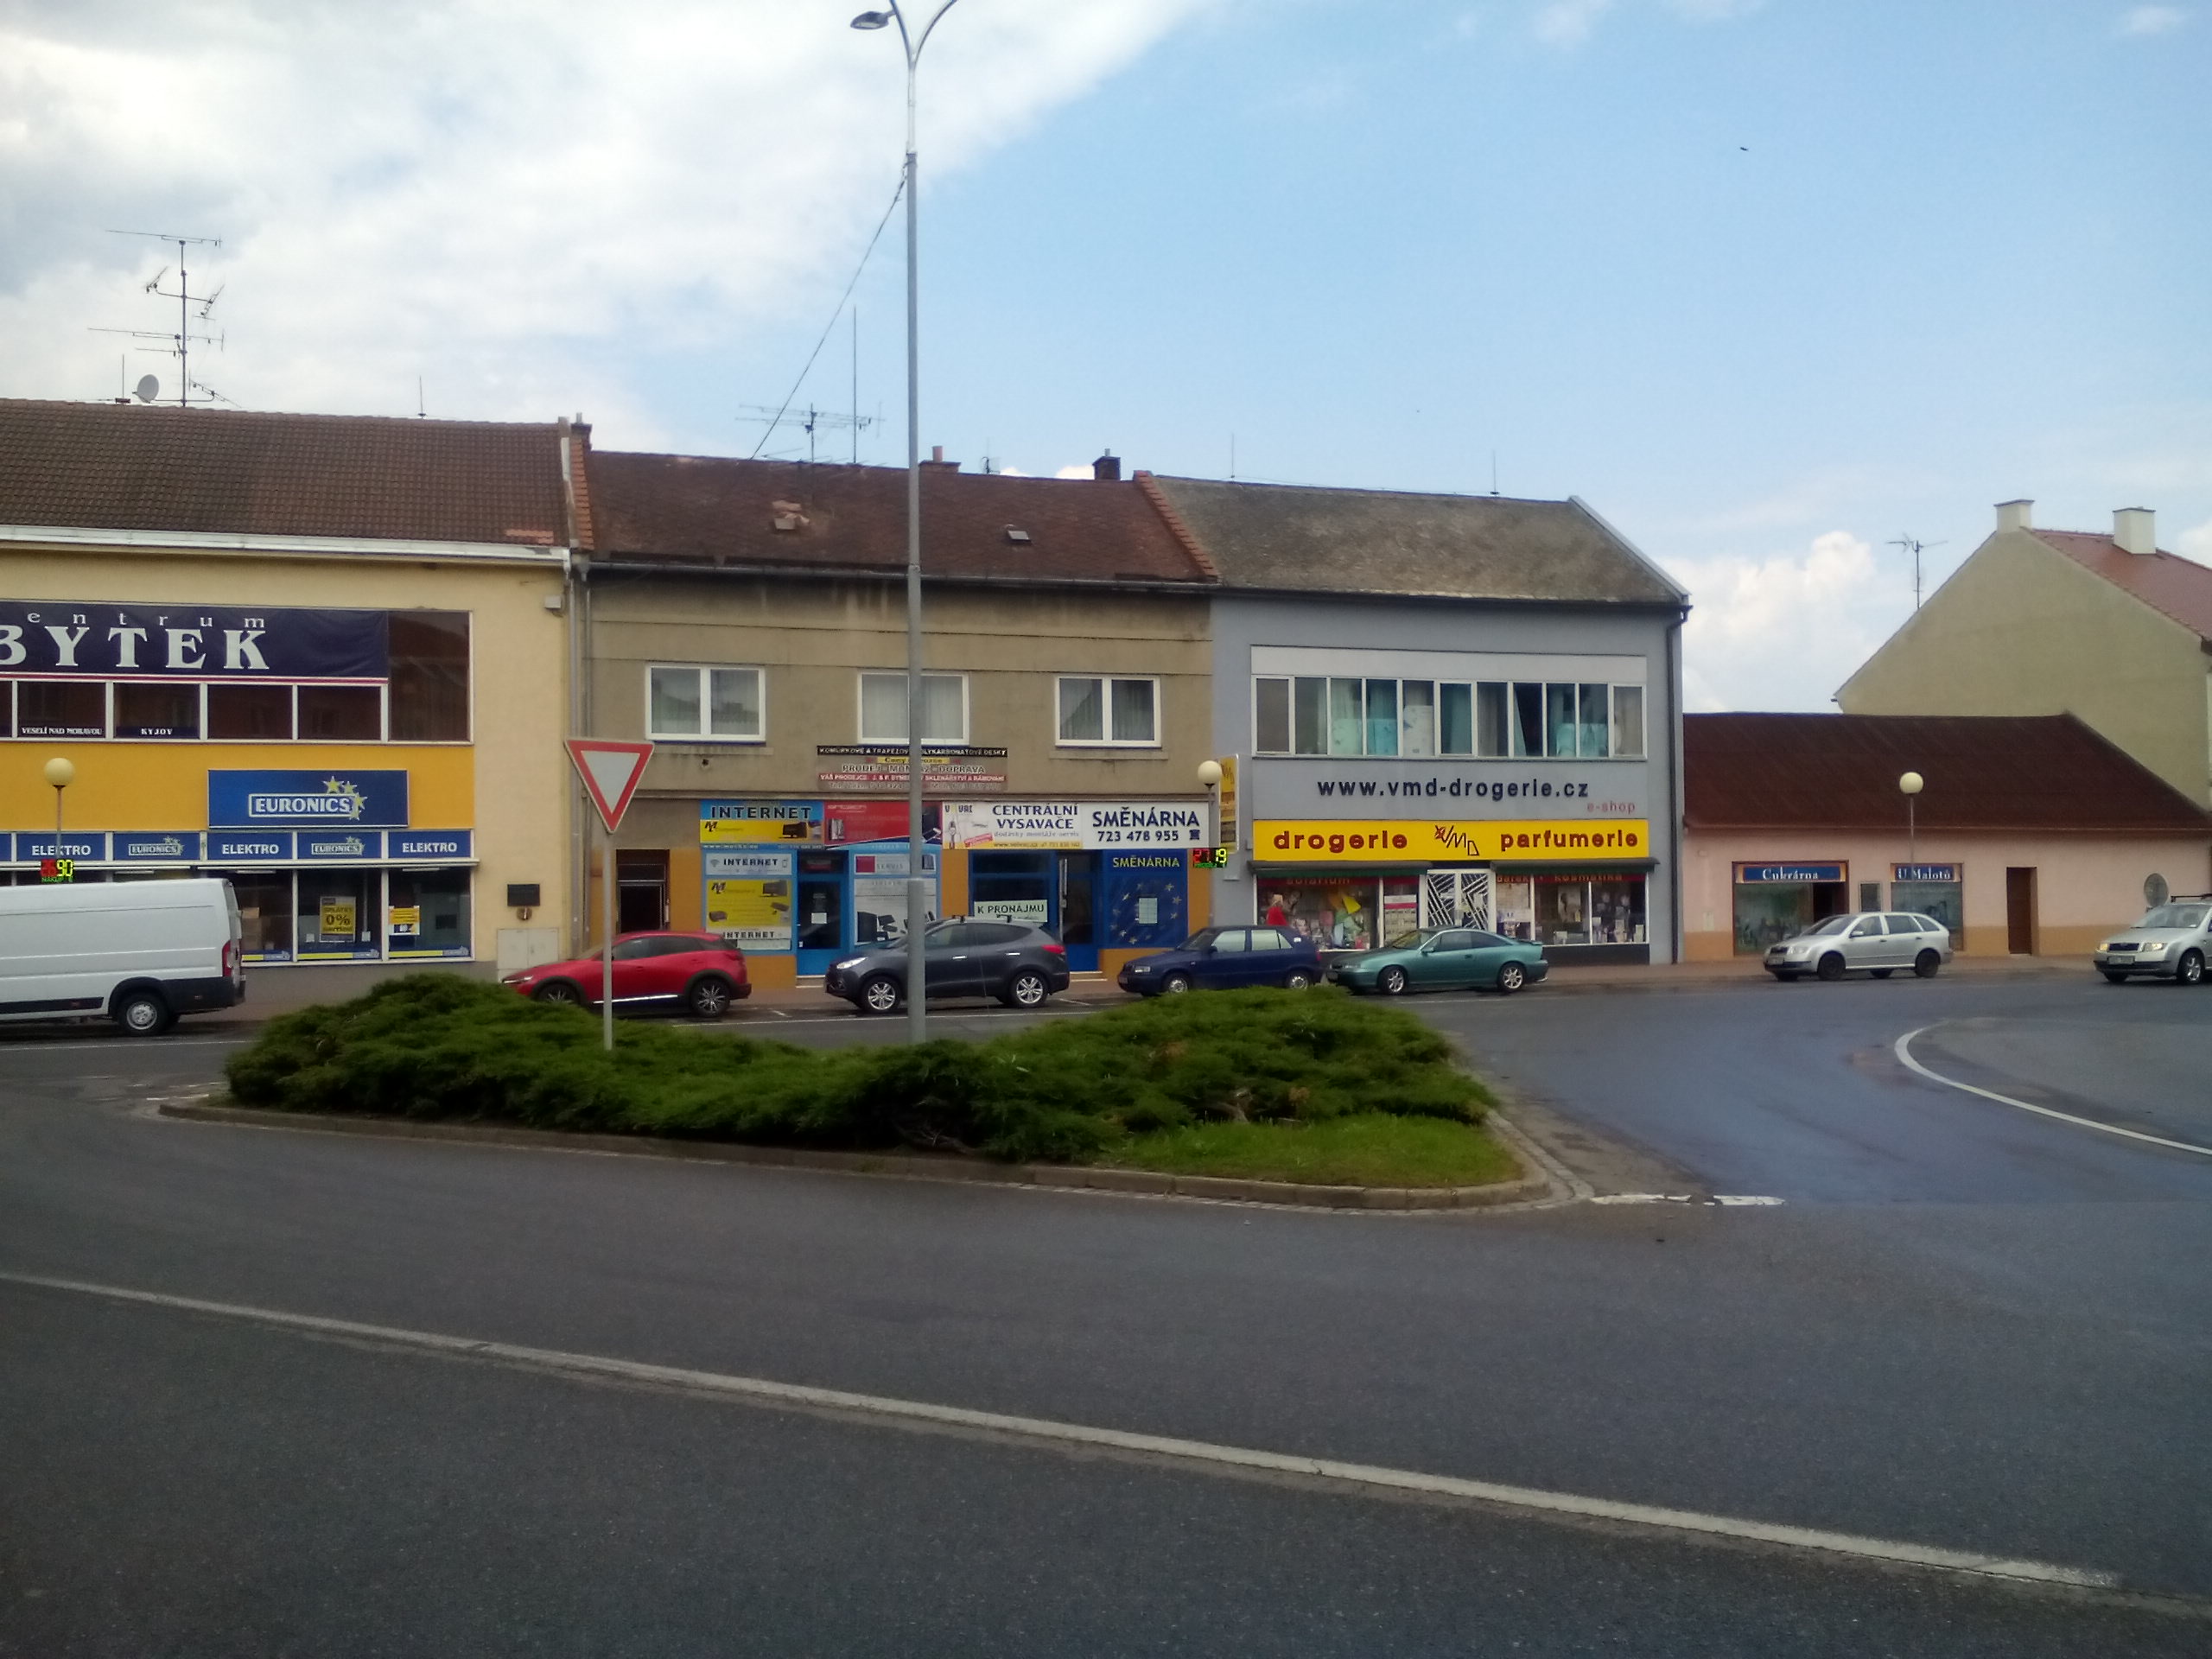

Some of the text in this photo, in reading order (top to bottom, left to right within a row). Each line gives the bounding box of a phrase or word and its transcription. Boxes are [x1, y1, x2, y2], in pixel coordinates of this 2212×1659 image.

[938, 765, 986, 774] DOPRAVA
[1318, 778, 1589, 801] www.vmd-drogerie.cz
[255, 798, 352, 813] EURONICS
[992, 803, 1079, 816] CENTRÁLNÍ
[1587, 800, 1636, 814] e-shop
[711, 806, 812, 819] INTERNET
[1092, 806, 1200, 827] SMĚNÁRNA
[997, 817, 1074, 830] VYSAVAČE
[1097, 830, 1179, 842] 723 478 955
[1273, 830, 1408, 854] drogerie
[1500, 830, 1638, 852] parfumerie
[32, 845, 92, 855] ELEKTRO
[222, 844, 279, 855] ELEKTRO
[402, 842, 458, 853] ELEKTRO
[723, 858, 779, 867] INTERNET
[1112, 855, 1181, 868] SMĚNÁRNA
[1763, 866, 1819, 880] Cukrárna
[977, 906, 984, 914] K
[722, 931, 775, 939] INTERNET
